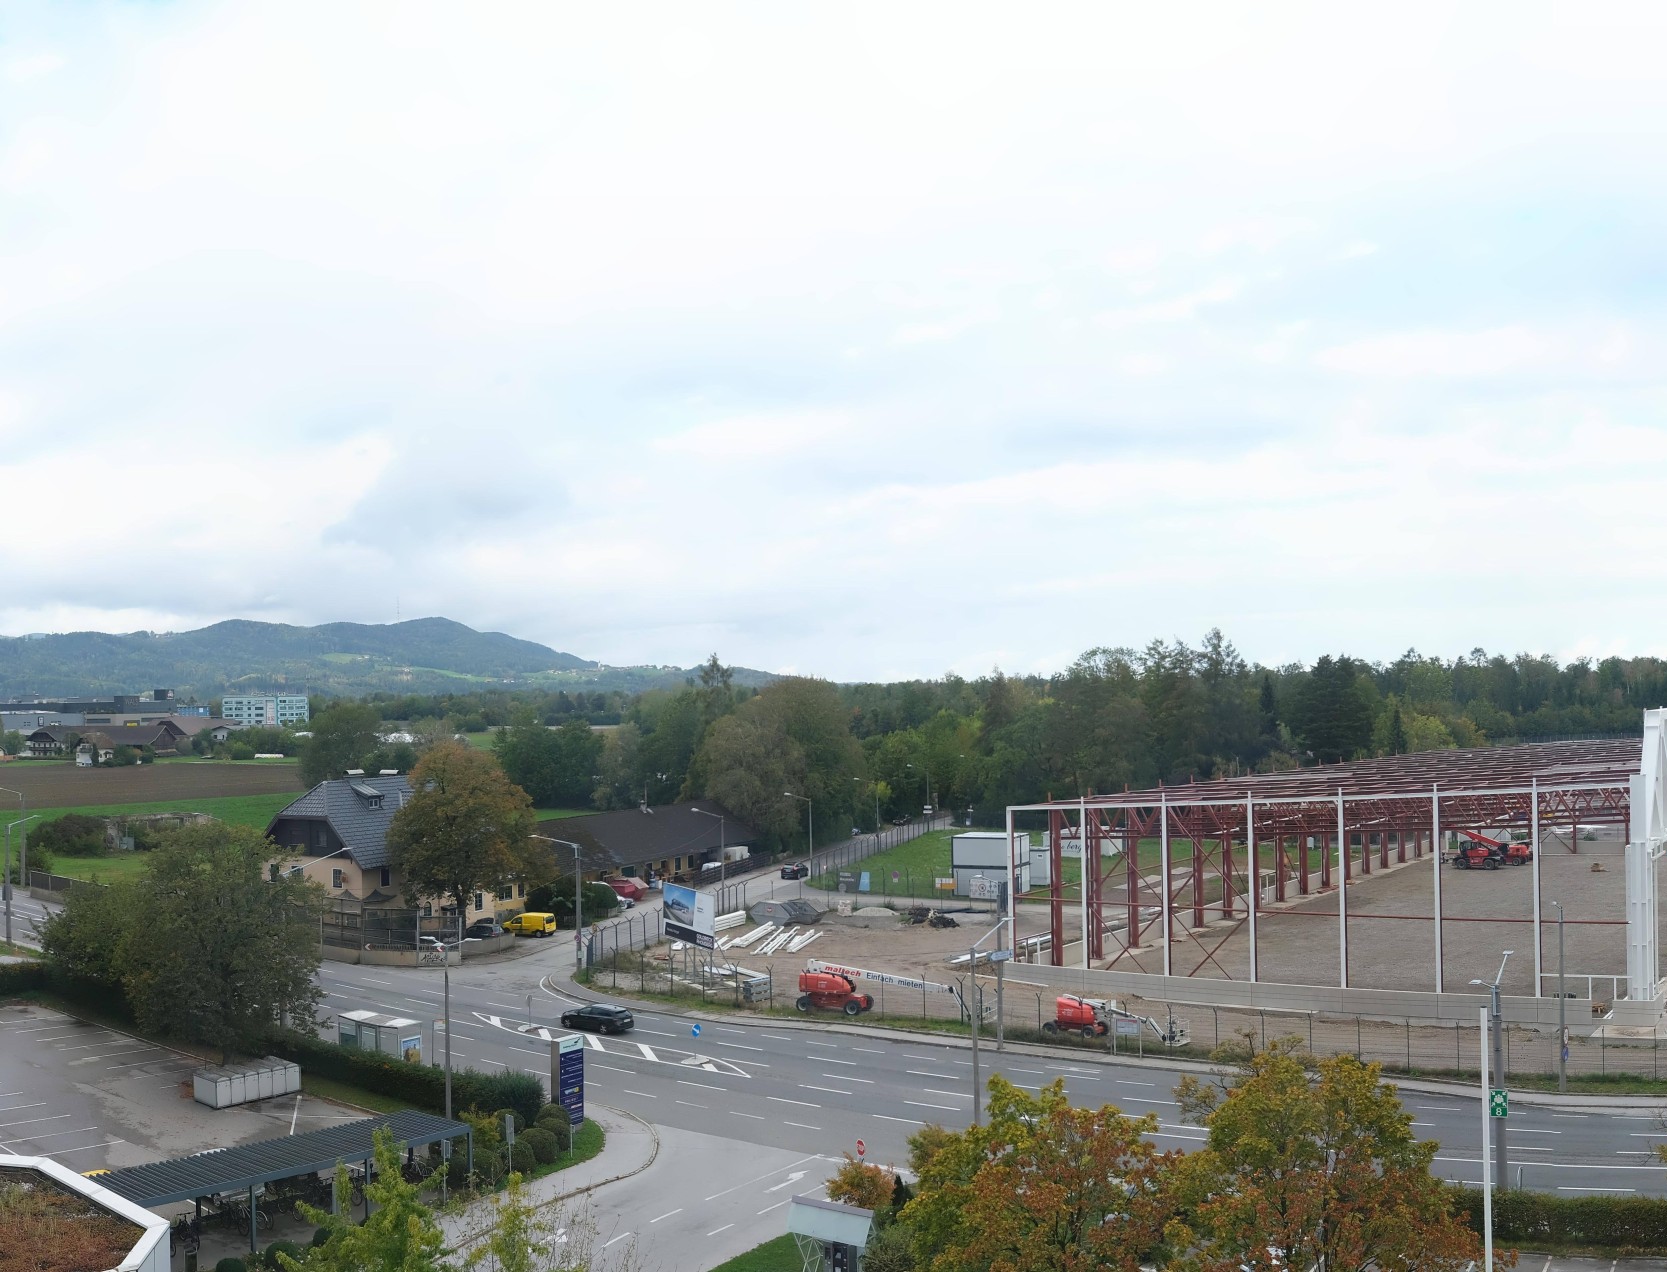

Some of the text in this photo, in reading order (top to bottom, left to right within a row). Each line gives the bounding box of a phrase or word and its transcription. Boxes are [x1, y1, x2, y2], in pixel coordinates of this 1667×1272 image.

[824, 965, 923, 990] maltech Einfach mieten
[1495, 1107, 1503, 1116] 8
